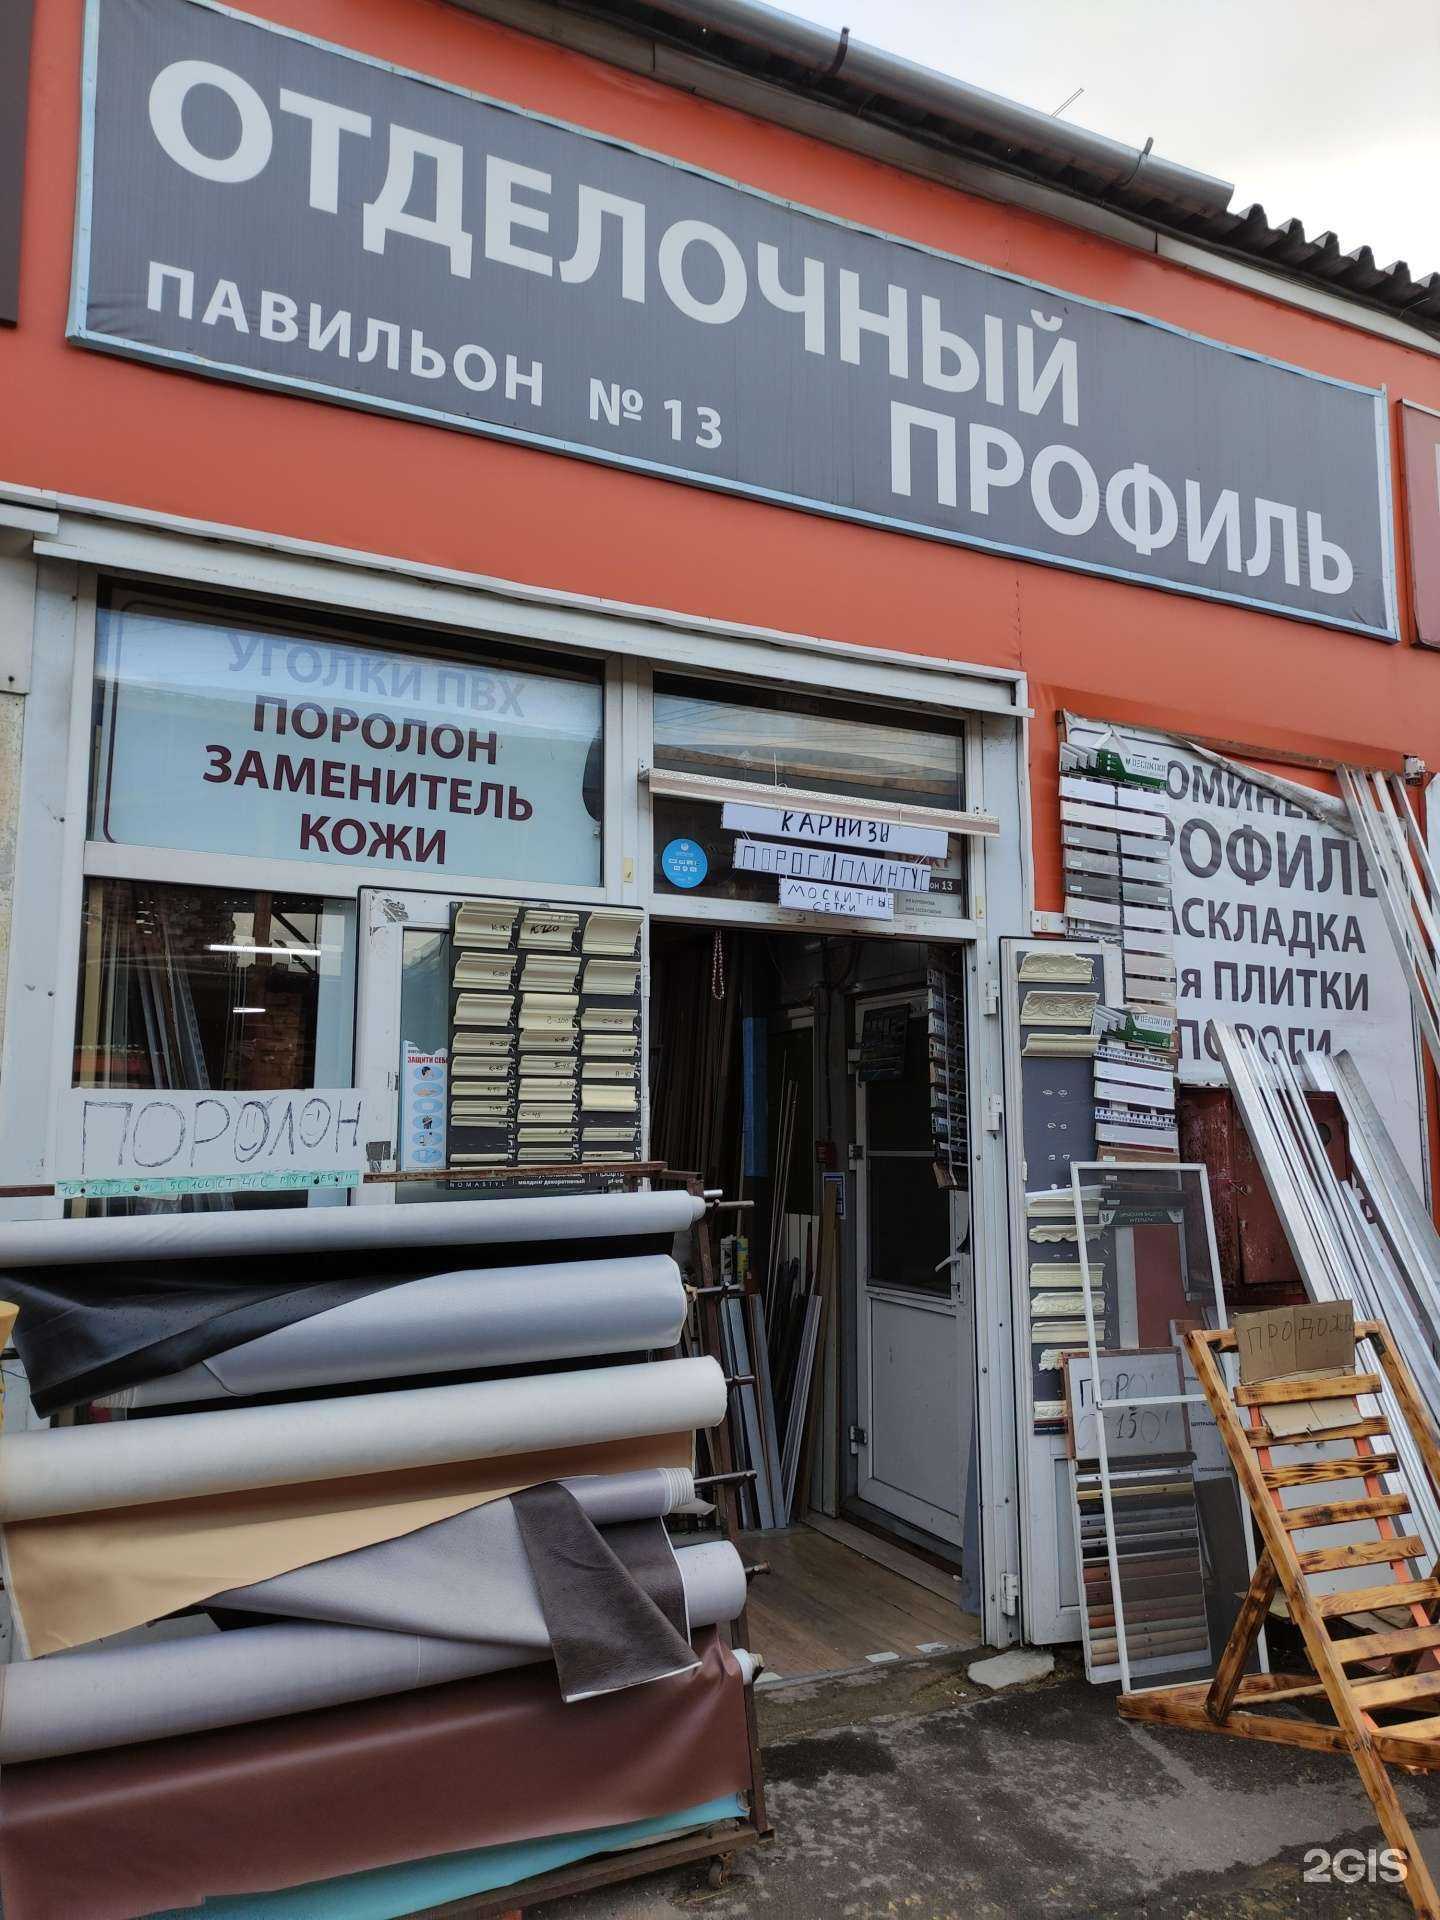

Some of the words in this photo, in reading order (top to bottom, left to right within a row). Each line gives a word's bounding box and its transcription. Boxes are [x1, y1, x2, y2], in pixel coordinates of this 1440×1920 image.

[149, 60, 1078, 426] ОТДЕЛОЧНЫЙ
[147, 261, 543, 406] ПАВИЛЬОН
[589, 378, 643, 425] №
[664, 399, 723, 449] 13
[891, 400, 1353, 594] ПРОФИЛЬ
[226, 631, 423, 701] УГОЛКИ
[438, 670, 525, 717] ПВХ
[254, 695, 497, 764] ПОРОЛОН
[204, 744, 533, 821] ЗАМЕНИТЕЛЬ
[300, 814, 446, 864] КОЖИ
[781, 811, 889, 843] КАРНИЗЫ
[813, 901, 855, 912] СЕТКИ
[942, 880, 953, 891] 13
[1214, 961, 1368, 1011] ПЛИТКИ
[408, 1056, 433, 1064] ЗАЩИТИ
[81, 1097, 362, 1175] ПОРОЛОН
